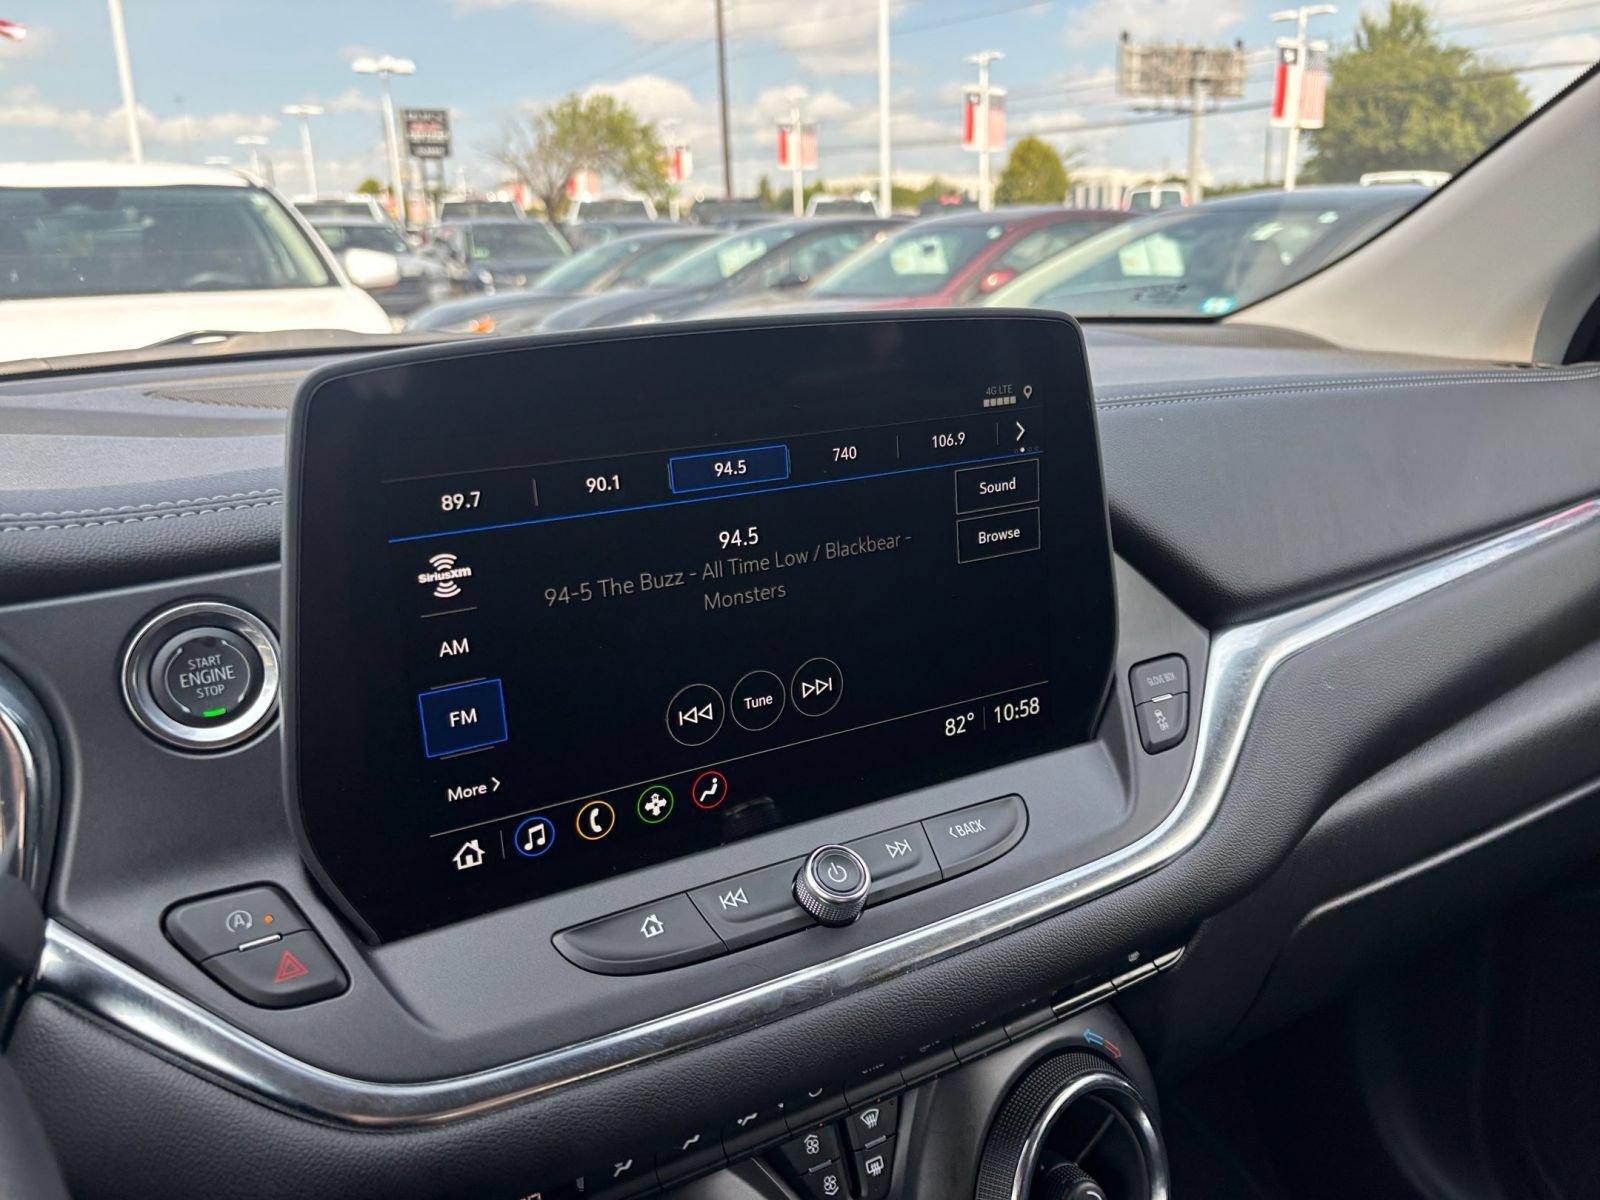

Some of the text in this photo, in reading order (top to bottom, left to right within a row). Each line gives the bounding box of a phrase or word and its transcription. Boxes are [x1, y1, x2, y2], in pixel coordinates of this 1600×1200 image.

[985, 384, 1013, 396] 4G LTE
[931, 431, 966, 449] 106.9
[832, 446, 857, 462] 740
[714, 460, 747, 477] 94.5
[585, 475, 620, 493] 90.1
[979, 476, 1016, 494] Sound
[441, 491, 481, 511] 89.7
[718, 526, 759, 549] 94.5
[978, 528, 1021, 545] Browse
[544, 582, 593, 607] 94-5
[597, 577, 635, 598] The
[641, 572, 685, 591] Buzz
[702, 561, 724, 580] All
[729, 557, 770, 575] Time
[776, 551, 809, 569] Low
[826, 536, 901, 560] Blackbear
[703, 582, 786, 610] Monsters
[439, 638, 470, 658] AM
[188, 654, 222, 670] START
[179, 665, 236, 689] ENGINE
[196, 684, 225, 699] STOP
[743, 694, 773, 710] Tune
[994, 696, 1041, 724] 10:58
[449, 708, 478, 728] FM
[447, 784, 488, 802] More
